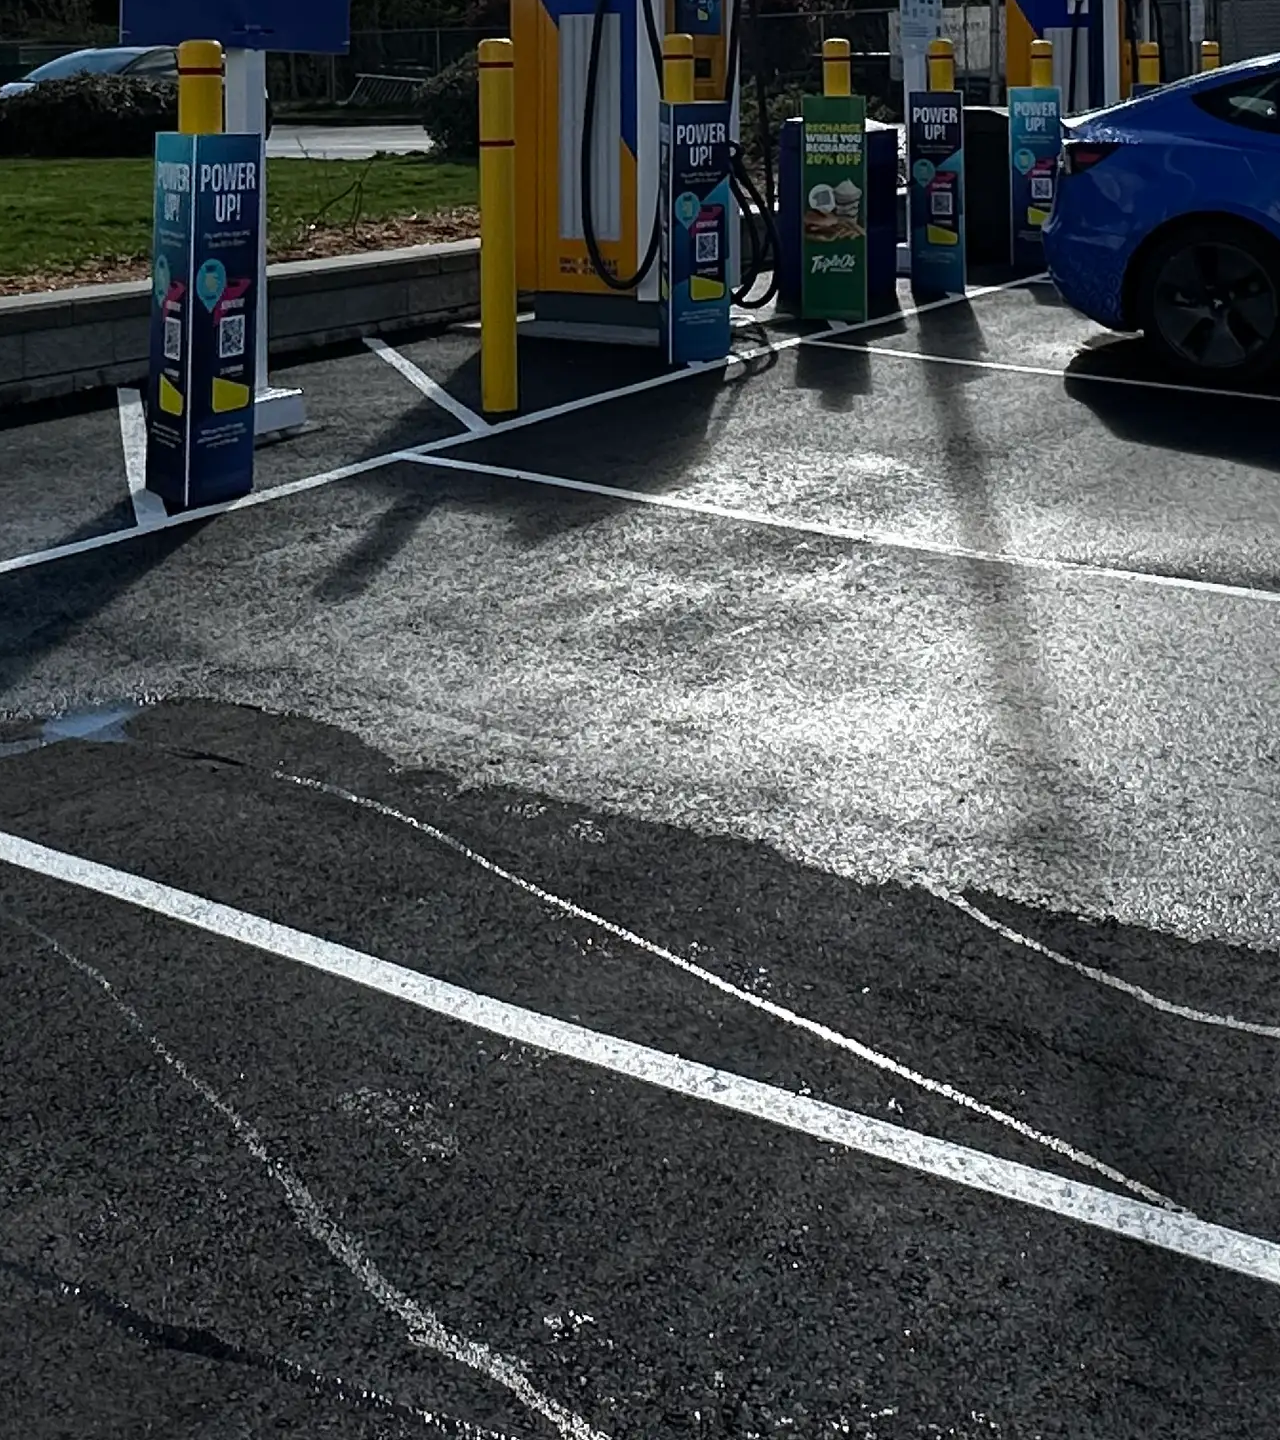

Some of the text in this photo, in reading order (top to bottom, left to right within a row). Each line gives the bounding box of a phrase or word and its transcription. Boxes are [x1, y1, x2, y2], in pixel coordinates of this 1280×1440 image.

[912, 106, 958, 124] POWER
[1013, 101, 1057, 118] POWER
[676, 122, 726, 145] POWER
[924, 124, 947, 141] UP!
[1025, 117, 1047, 132] UP!
[805, 133, 862, 143] WHILE YOU
[689, 145, 713, 167] UP!
[805, 153, 861, 165] 20% OFF
[157, 161, 190, 193] POWER
[200, 162, 256, 192] POWER
[164, 193, 181, 222] UP!
[215, 192, 242, 223] UP!
